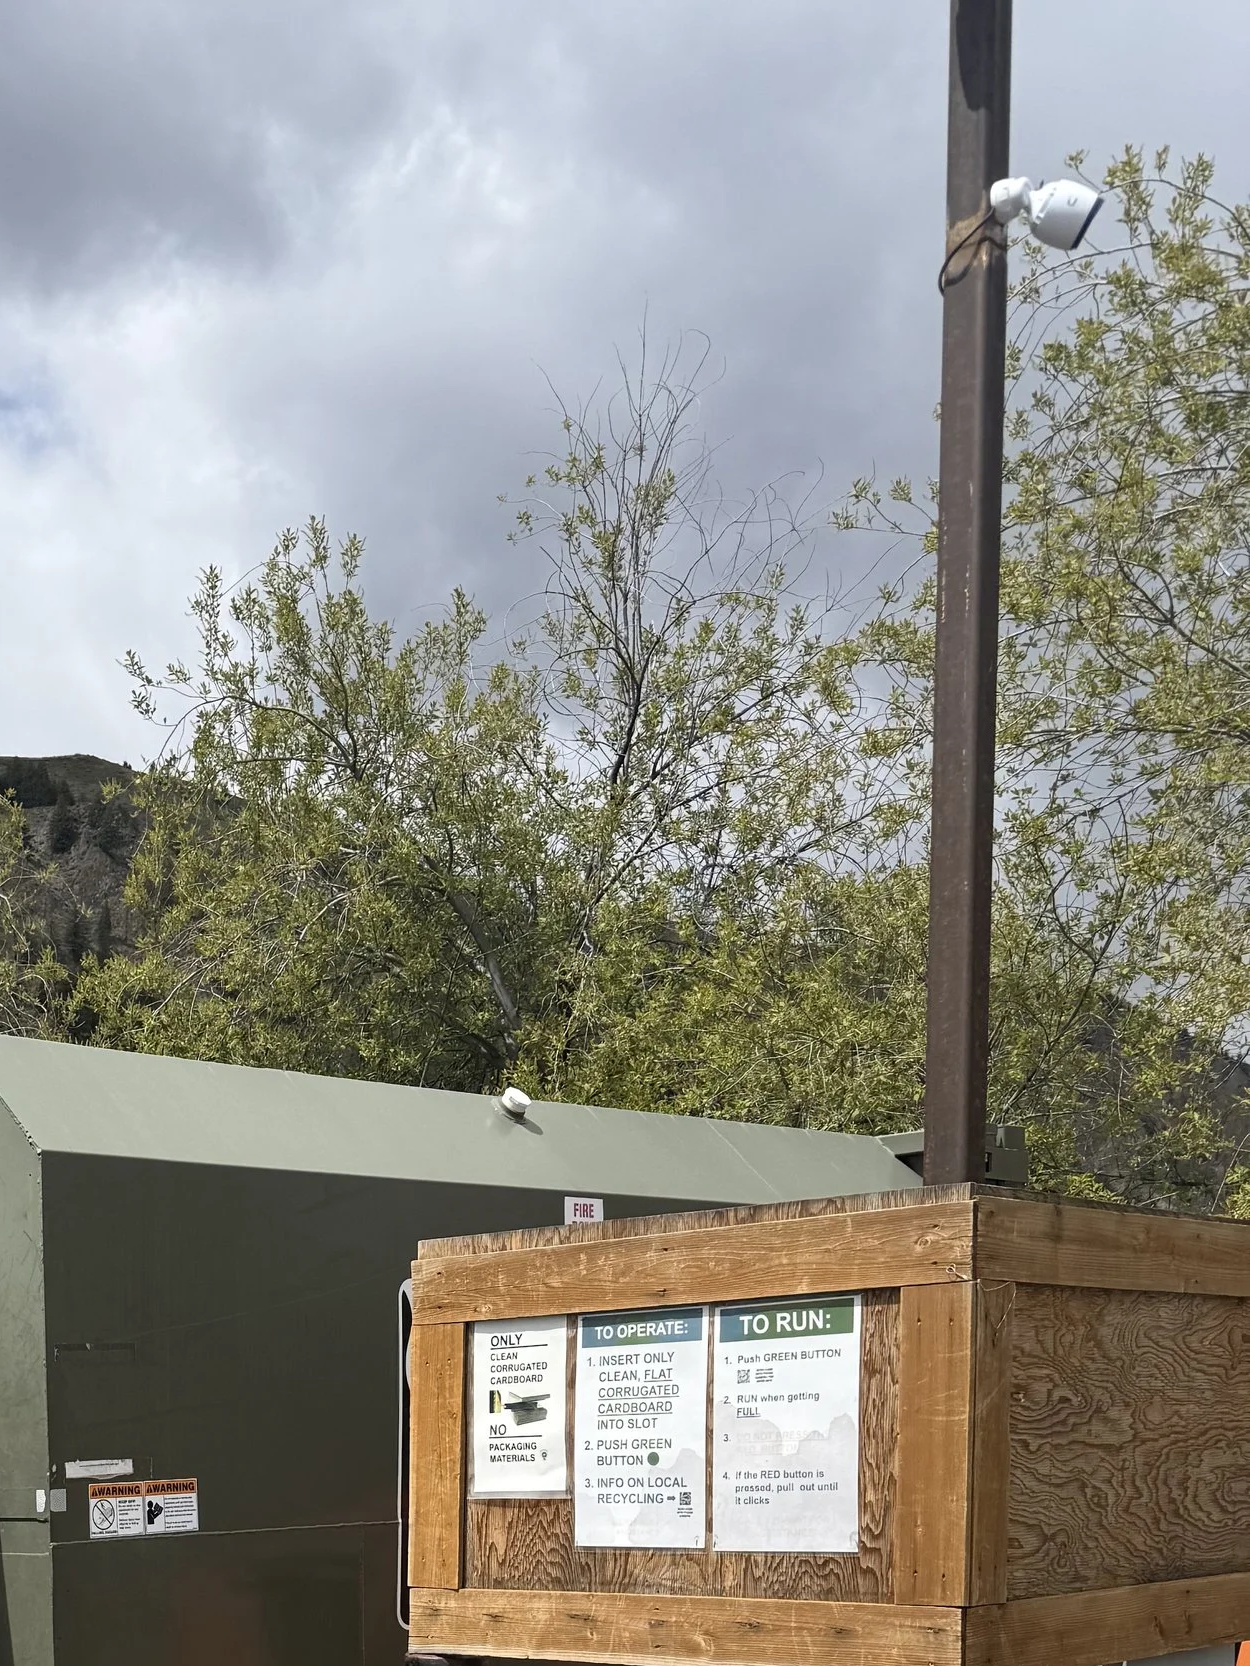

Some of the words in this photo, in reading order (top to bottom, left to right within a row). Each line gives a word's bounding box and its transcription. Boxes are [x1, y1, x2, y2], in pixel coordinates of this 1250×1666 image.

[574, 1203, 594, 1218] FIRE
[740, 1314, 769, 1335] TO
[776, 1310, 831, 1333] RUN:
[594, 1326, 614, 1340] TO
[617, 1320, 689, 1339] OPERATE:
[490, 1334, 523, 1348] ONLY
[490, 1352, 518, 1362] CLEAN
[587, 1357, 596, 1367] 1.
[599, 1354, 641, 1366] INSERT
[644, 1352, 675, 1364] ONLY
[724, 1356, 732, 1365] 1.
[738, 1354, 761, 1364] Push
[764, 1352, 798, 1362] GREEN
[801, 1348, 842, 1360] BUTTON
[490, 1362, 548, 1373] CORRUGATED
[490, 1374, 543, 1385] CARDBOARD
[599, 1370, 641, 1383] CLEAN,
[644, 1368, 673, 1380] FLAT
[598, 1384, 680, 1398] CORRUGATED
[723, 1396, 731, 1405] 2.
[737, 1394, 758, 1404] RUN
[760, 1394, 785, 1402] when
[788, 1392, 820, 1403] getting
[598, 1401, 673, 1414] CARDBOARD
[736, 1407, 760, 1416] FULL
[490, 1424, 507, 1436] NO
[598, 1418, 624, 1430] INTO
[628, 1418, 658, 1429] SLOT
[489, 1442, 537, 1451] PACKAGING
[584, 1440, 594, 1451] 2.
[597, 1440, 628, 1450] PUSH
[632, 1438, 672, 1450] GREEN
[490, 1454, 536, 1463] MATERIALS
[597, 1454, 643, 1466] BUTTON
[744, 1471, 758, 1479] the
[760, 1470, 781, 1479] RED
[784, 1470, 813, 1478] button
[817, 1470, 825, 1478] is
[584, 1478, 594, 1488] 3.
[598, 1478, 624, 1488] INFO
[628, 1477, 644, 1488] ON
[648, 1477, 688, 1488] LOCAL
[736, 1484, 774, 1493] pressed,
[777, 1483, 794, 1493] pull
[818, 1482, 838, 1491] until
[98, 1486, 141, 1496] WARNING
[152, 1482, 195, 1493] WARNING
[597, 1493, 664, 1505] RECYCLING
[736, 1496, 741, 1505] it
[744, 1496, 770, 1505] clicks
